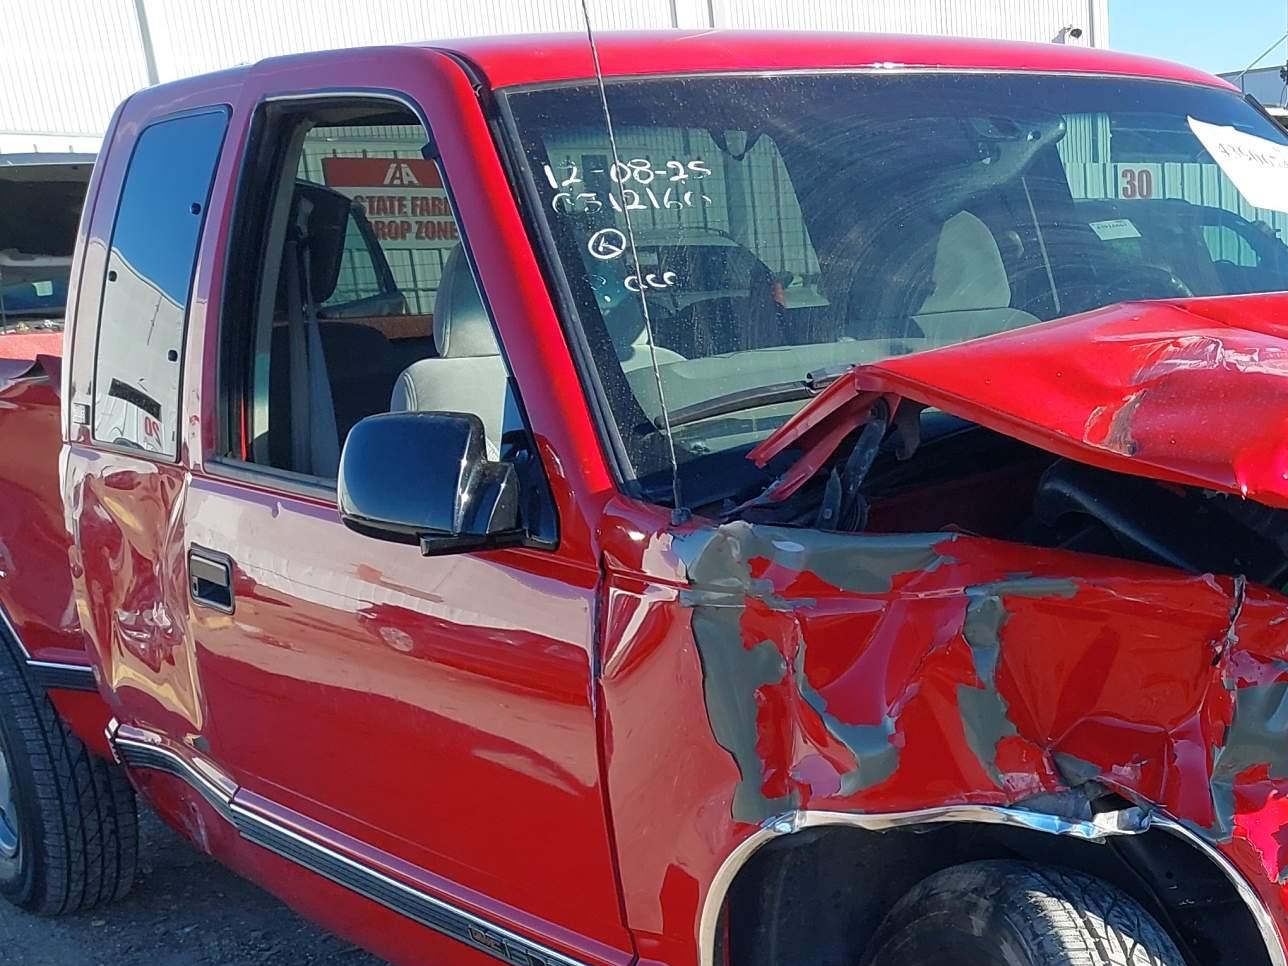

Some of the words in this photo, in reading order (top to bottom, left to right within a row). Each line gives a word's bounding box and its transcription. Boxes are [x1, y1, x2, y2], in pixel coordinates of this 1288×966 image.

[1121, 168, 1153, 199] 30
[370, 220, 412, 240] ROP
[415, 221, 458, 240] ZONE
